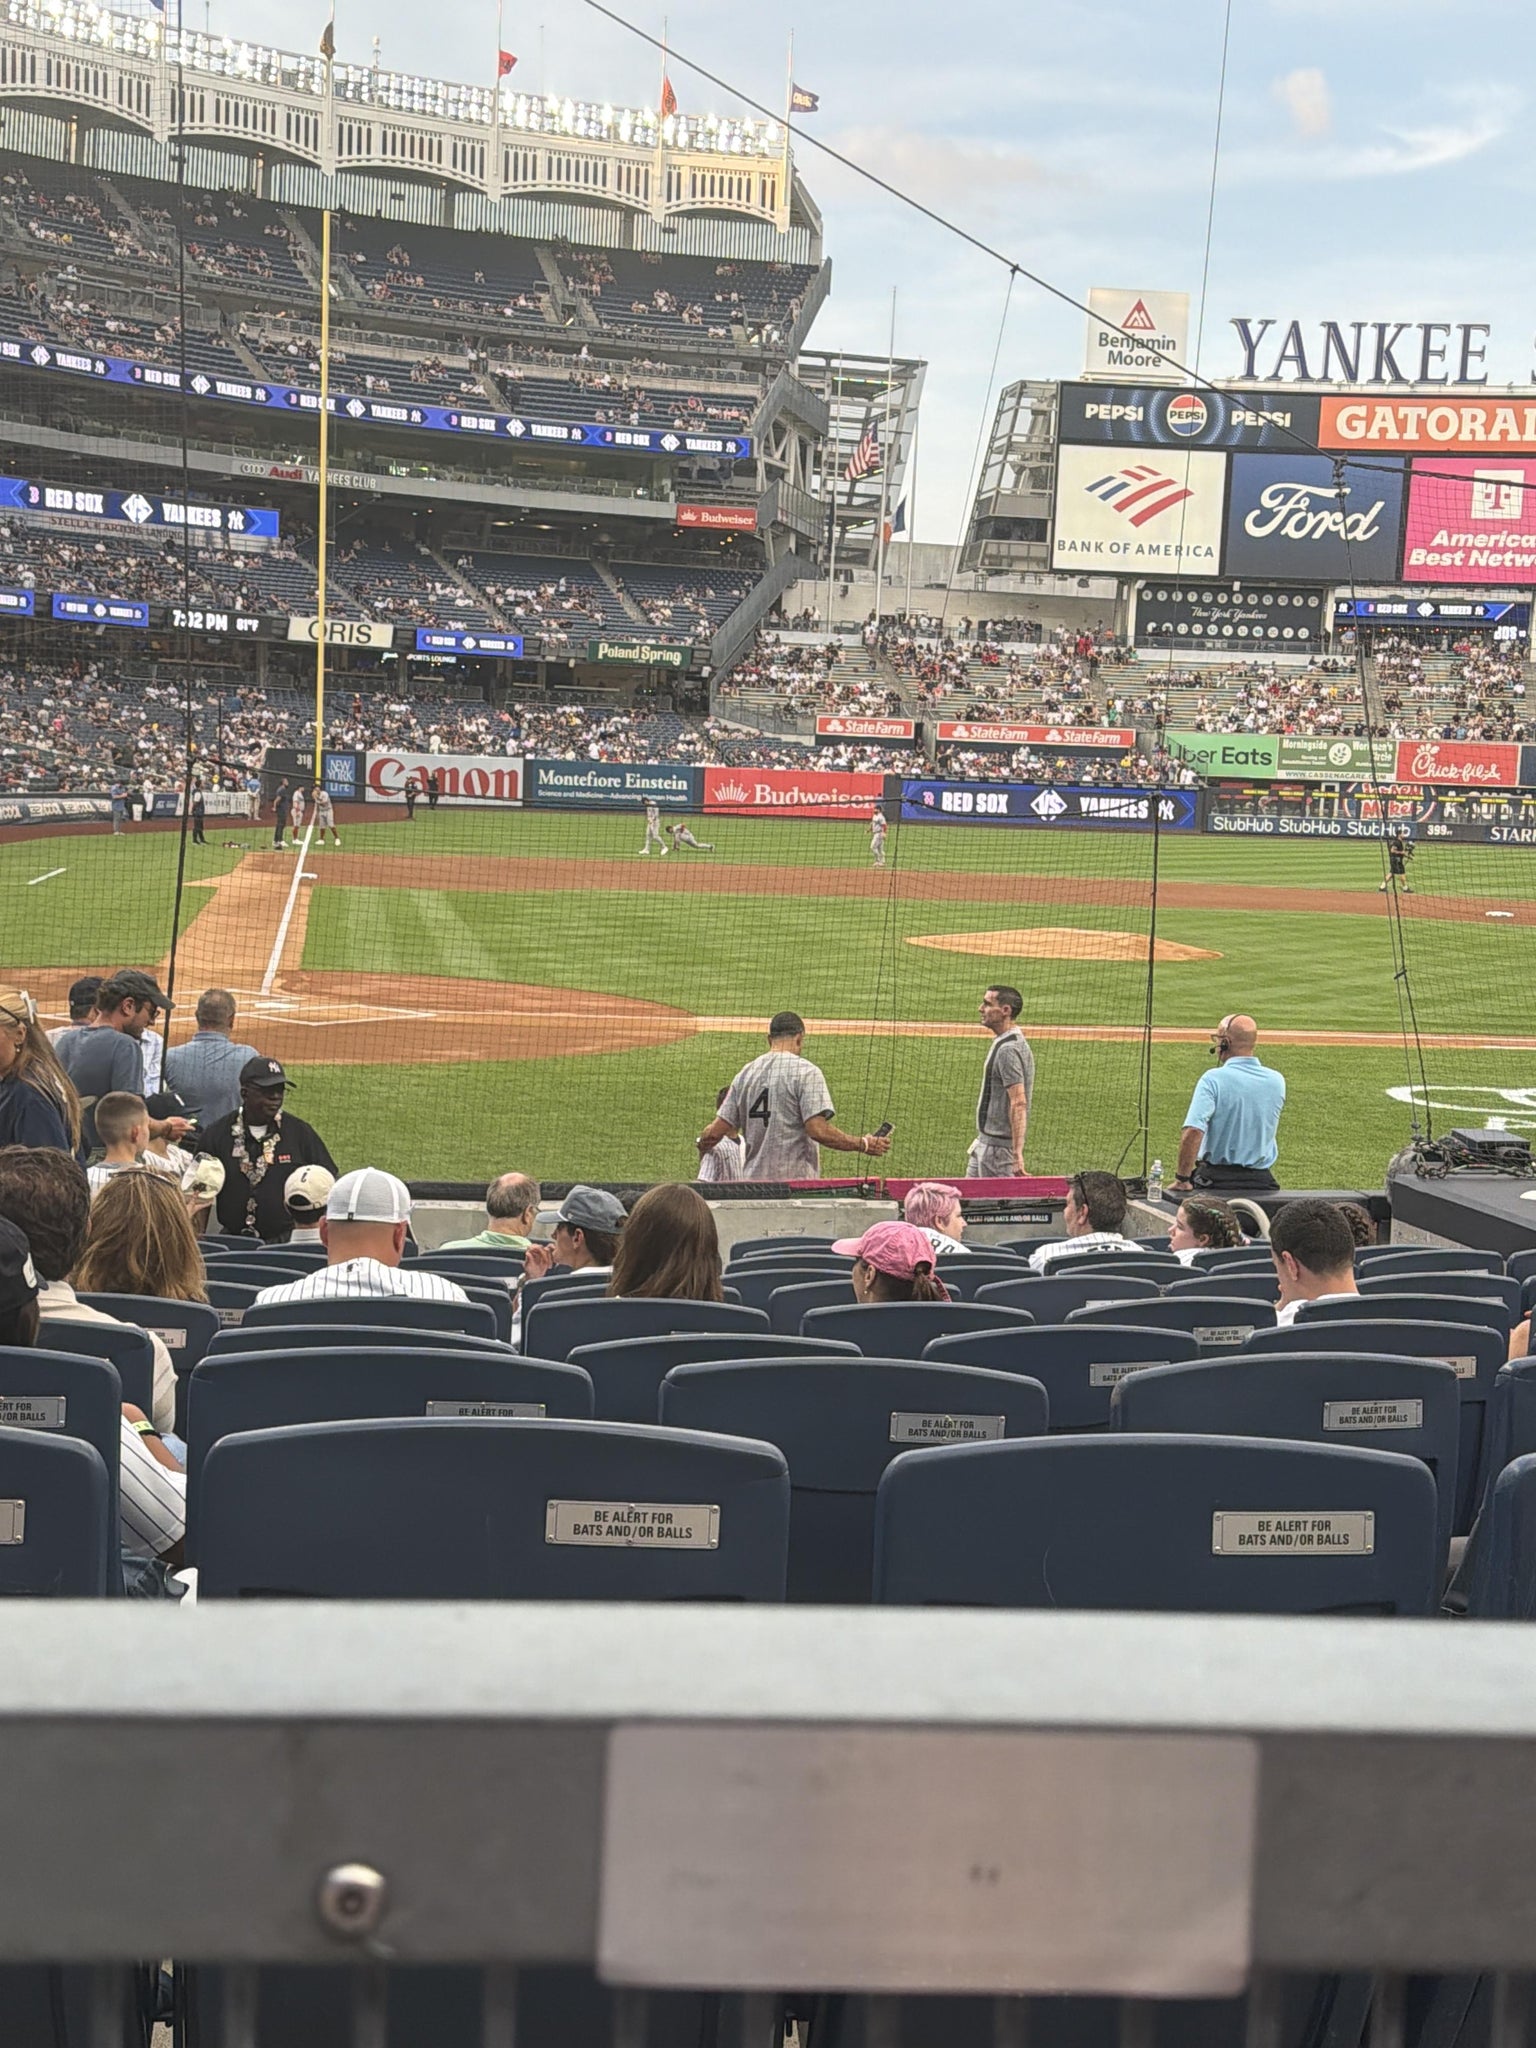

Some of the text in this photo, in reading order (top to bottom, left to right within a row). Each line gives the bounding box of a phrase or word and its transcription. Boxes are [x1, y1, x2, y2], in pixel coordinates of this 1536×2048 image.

[1098, 332, 1176, 352] Benjamin
[1107, 350, 1162, 367] Moore
[1230, 317, 1491, 386] YANKEE
[1085, 403, 1144, 421] PEPSI
[1169, 410, 1204, 421] PEPSI
[1231, 410, 1291, 428] PEPSI
[268, 466, 304, 480] Audi
[353, 475, 377, 489] CLUB
[45, 488, 74, 510] RED
[75, 491, 104, 514] SOX
[701, 512, 754, 525] Budweiser
[1243, 482, 1385, 542] Ford
[1057, 539, 1215, 558] BANK OF AMERICA
[1408, 548, 1466, 566] Best
[206, 612, 228, 631] PM
[308, 620, 373, 645] ORIS
[598, 643, 682, 666] Poland Spring
[1282, 738, 1328, 752] Morningside
[1221, 746, 1273, 766] Eats
[330, 759, 351, 771] NEW
[1411, 748, 1501, 782] Chick-fil-A
[328, 768, 354, 782] YORK
[369, 757, 519, 801] Canon
[538, 769, 688, 791] Montefiore Einstein
[538, 789, 562, 798] Science
[563, 790, 574, 798] and
[666, 794, 688, 802] Health
[754, 783, 876, 808] Budweiser
[942, 791, 973, 812] RED
[976, 793, 1008, 813] SOX
[1080, 796, 1149, 819] YANKEES
[1213, 816, 1274, 833] StubHub
[1279, 818, 1340, 835] StubHub
[1427, 824, 1447, 836] 399
[748, 1087, 771, 1128] 4
[1032, 1214, 1049, 1223] BALLS
[16, 1402, 32, 1411] FOR
[459, 1407, 514, 1417] BE ALERT FOR
[1351, 1405, 1397, 1415] BE ALERT FOR
[20, 1412, 46, 1421] BALLS
[922, 1419, 975, 1429] BE ALERT FOR
[1339, 1413, 1408, 1425] BATS AND/OR BALLS
[908, 1428, 987, 1439] BATS AND/OR BALLS
[594, 1510, 673, 1525] BE ALERT FOR
[1258, 1520, 1331, 1532] BE ALERT FOR
[573, 1523, 693, 1539] BATS AND/OR BALLS
[1238, 1533, 1350, 1547] BATS AND/OR BALLS
